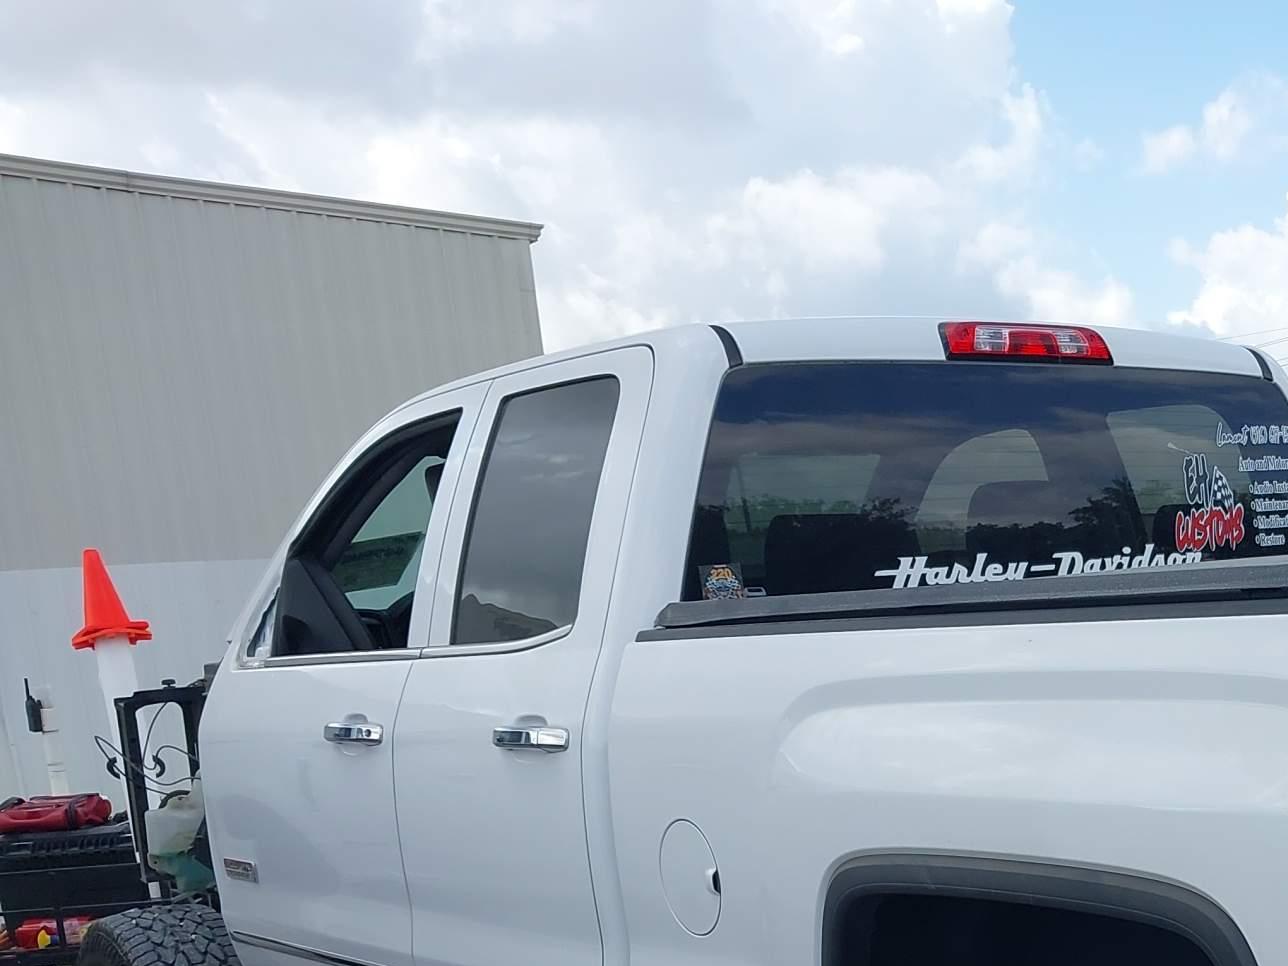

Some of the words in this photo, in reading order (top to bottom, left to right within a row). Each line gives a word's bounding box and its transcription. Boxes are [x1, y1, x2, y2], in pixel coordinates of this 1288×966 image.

[1238, 456, 1255, 471] Auto
[1255, 456, 1268, 470] and
[1254, 481, 1273, 494] Audio
[1259, 533, 1286, 546] Restore
